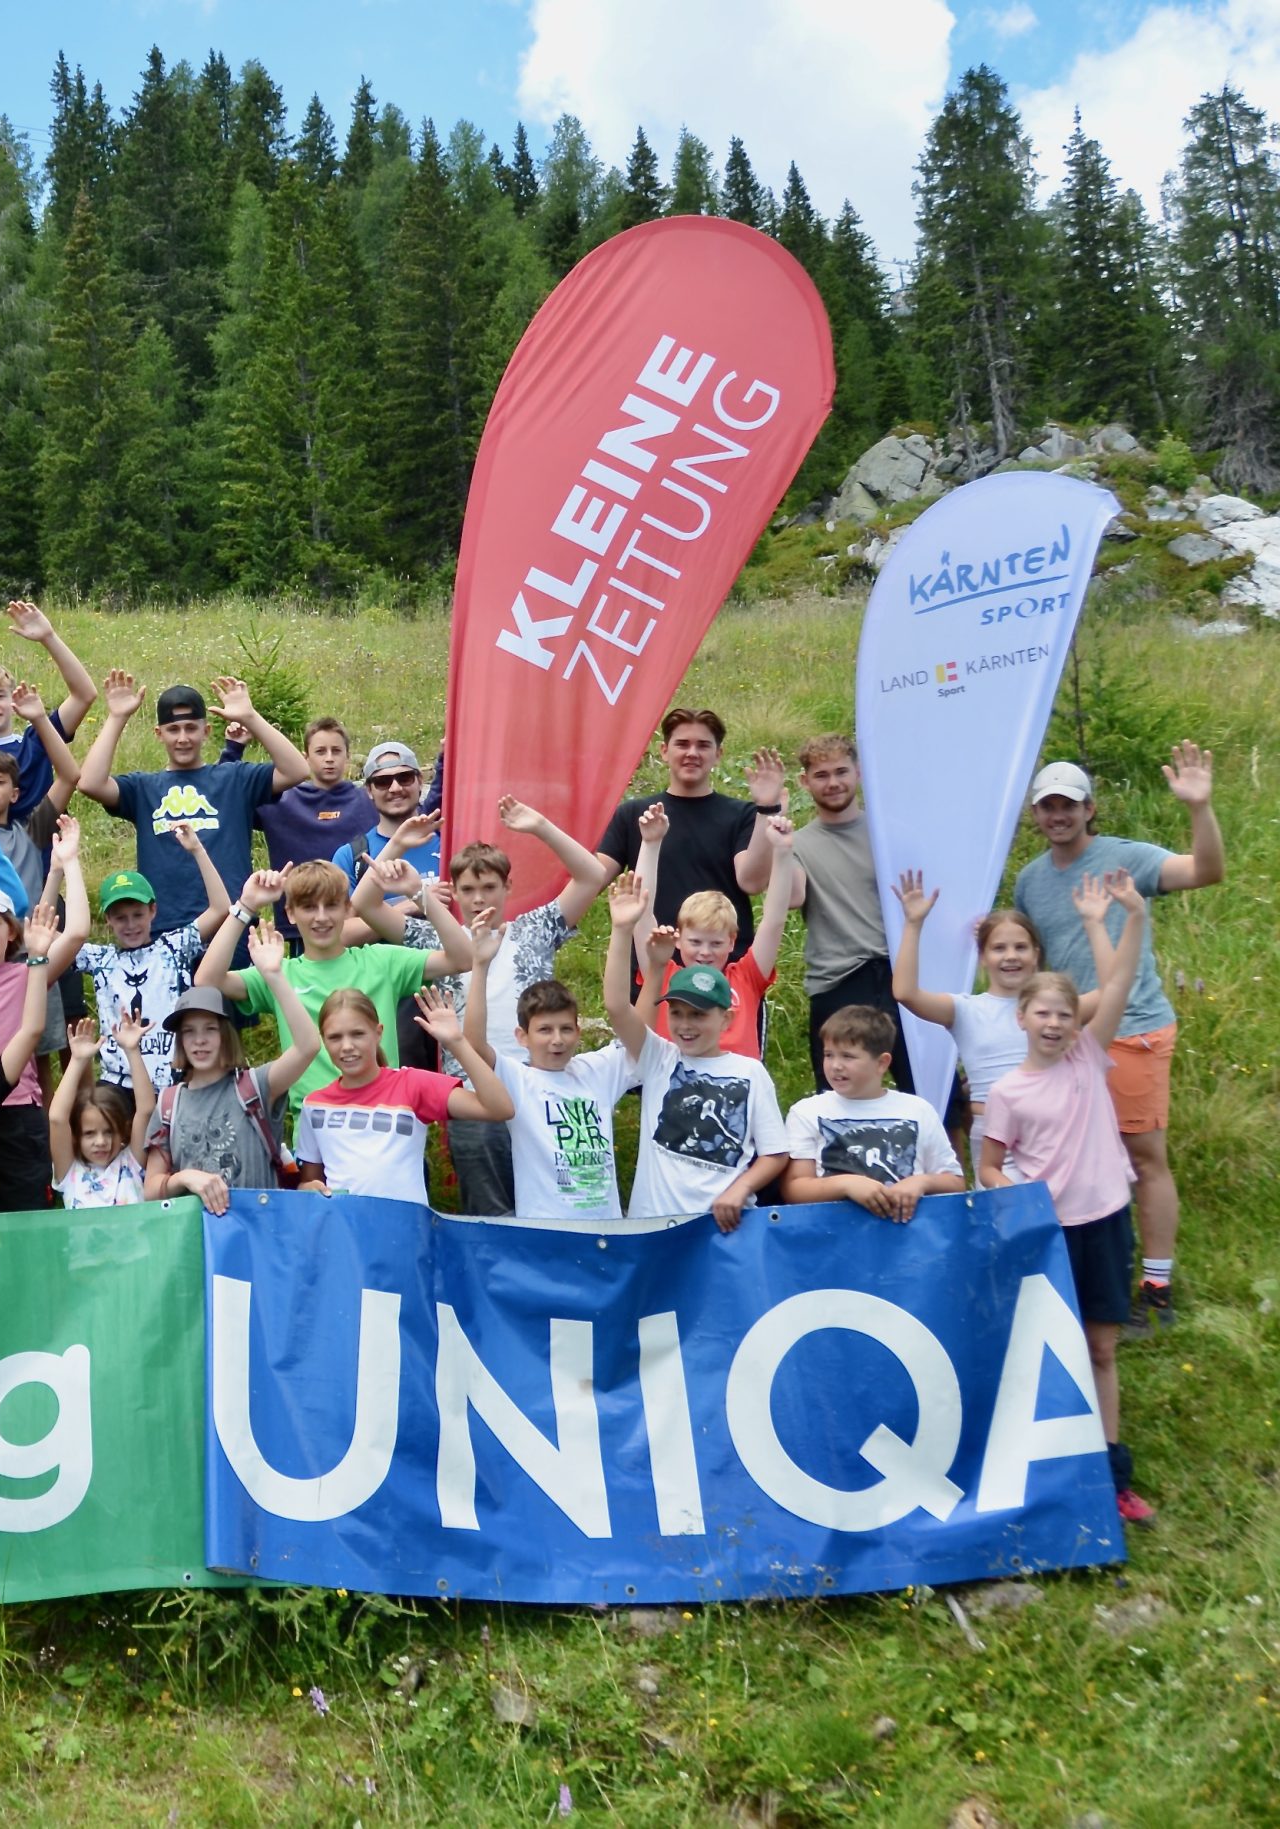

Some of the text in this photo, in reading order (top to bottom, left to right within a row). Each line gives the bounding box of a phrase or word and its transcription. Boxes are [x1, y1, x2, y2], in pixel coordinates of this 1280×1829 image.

[495, 334, 716, 671] KLEINE
[562, 371, 780, 706] ZEITUNG
[910, 524, 1070, 605] KÄRNTEN
[980, 592, 1071, 625] SPORT
[881, 644, 1049, 693] LAND KÄRNTEN
[937, 685, 966, 698] Sport
[554, 1150, 606, 1167] PAPERC
[212, 1272, 1107, 1539] UNIQA
